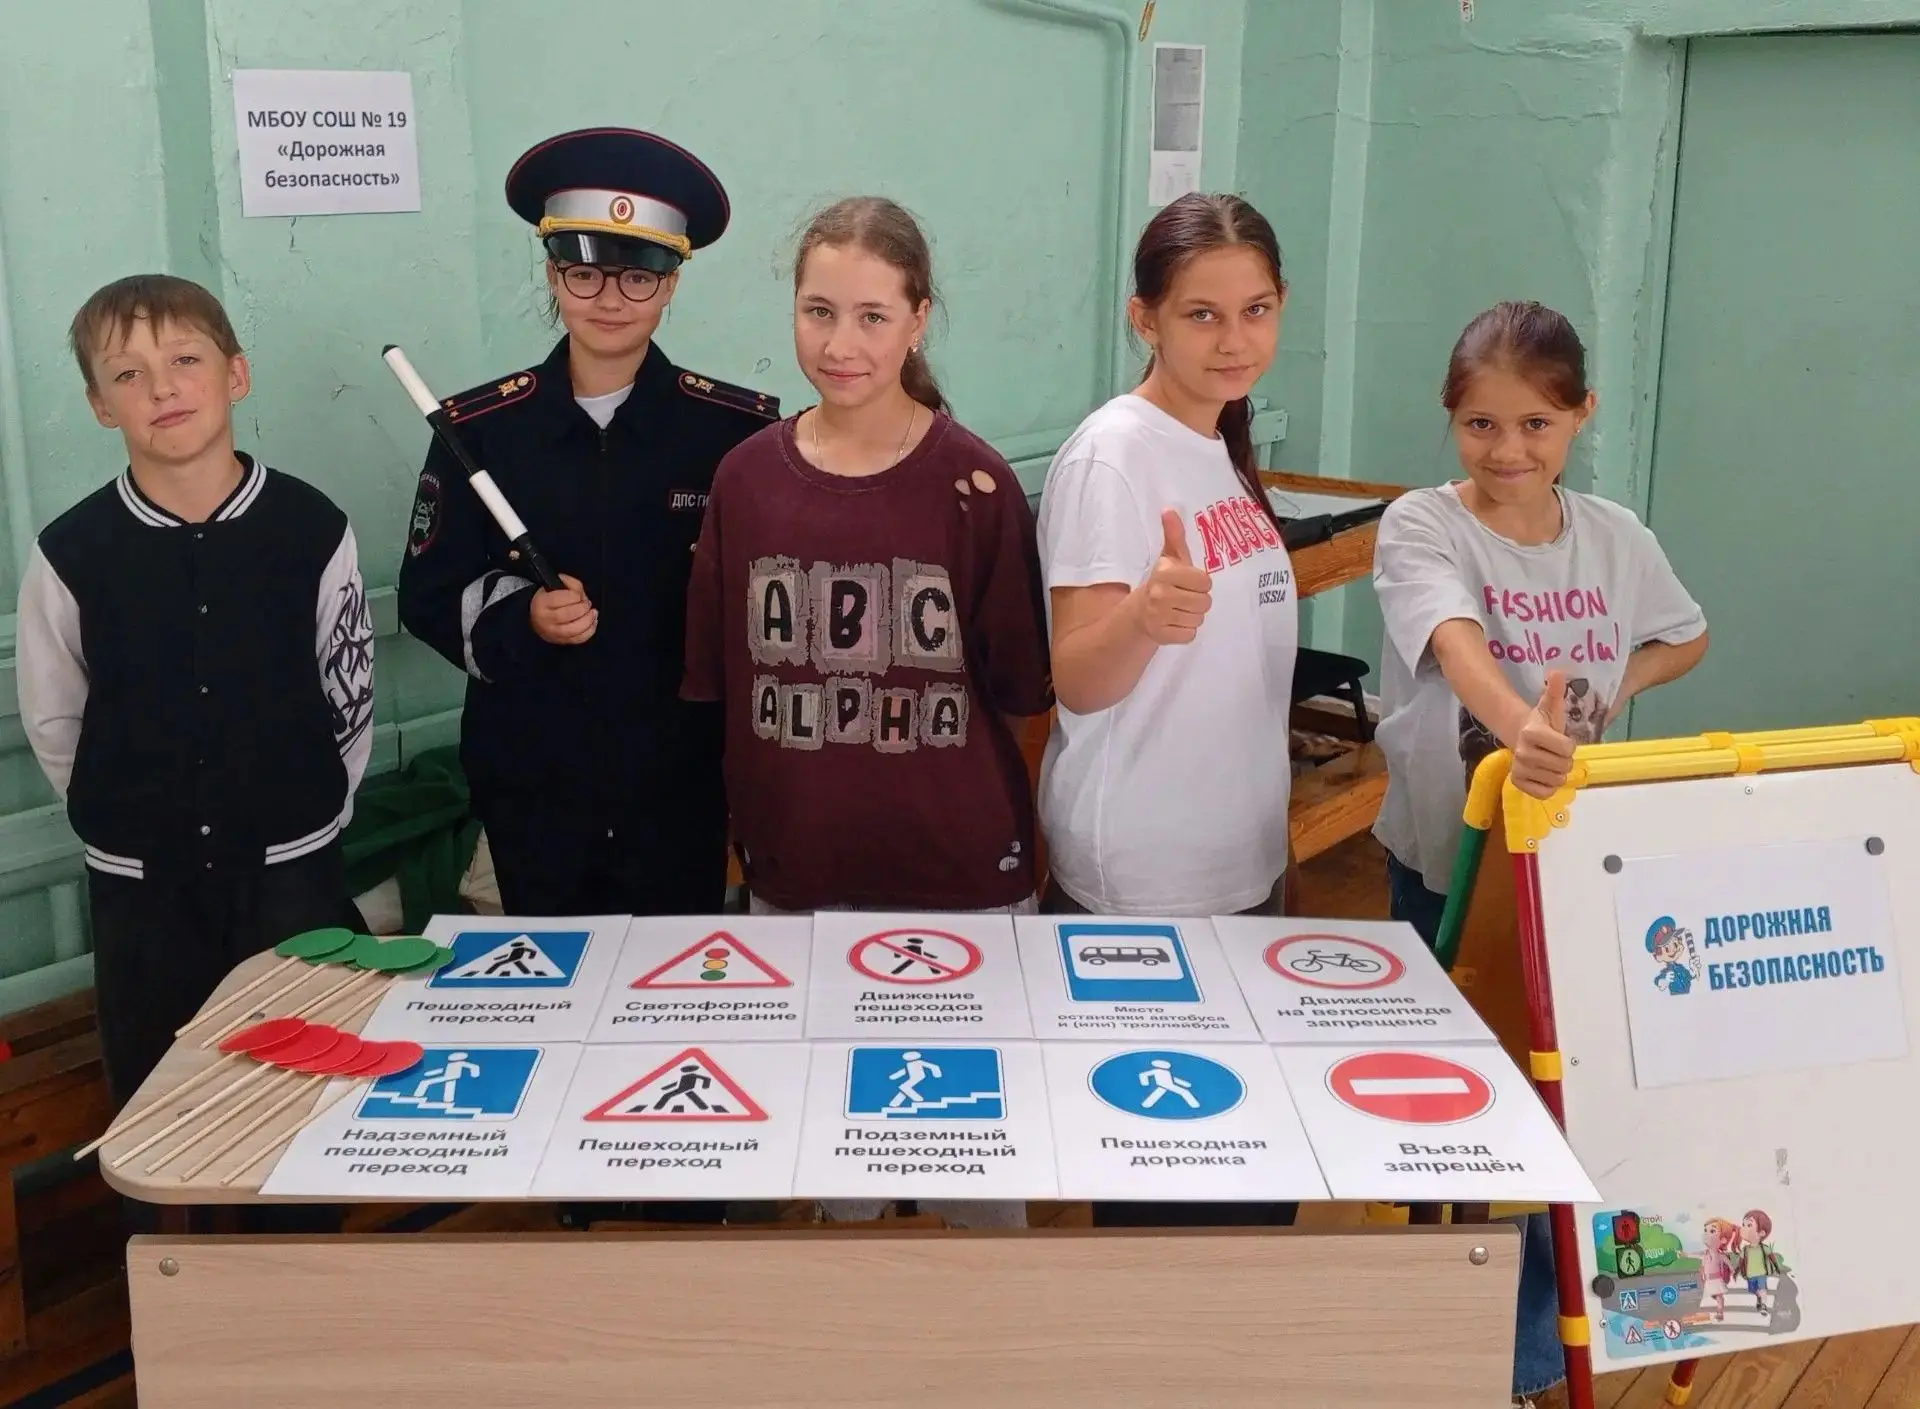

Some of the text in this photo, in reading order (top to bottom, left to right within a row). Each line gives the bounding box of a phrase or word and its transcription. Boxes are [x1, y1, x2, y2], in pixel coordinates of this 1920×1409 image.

[247, 110, 407, 128] МБОУ СОШ № 19
[277, 141, 385, 161] «Дорожная
[265, 170, 400, 188] безопасность»
[672, 493, 697, 509] ДПС
[1194, 495, 1280, 575] MOSC
[759, 686, 960, 742] ALPHA
[1704, 905, 1832, 949] ДОРОЖНАЯ
[1707, 946, 1885, 991] БЕЗОПАСНОСТЬ
[859, 991, 975, 1002] Движение
[1299, 996, 1416, 1007] Движение
[405, 1000, 573, 1012] Пешеходный
[624, 1000, 790, 1012] Светофорное
[853, 1003, 983, 1012] пешеходов
[1114, 1005, 1165, 1013] Место
[1277, 1006, 1453, 1017] на велосипеде
[429, 1014, 536, 1025] переход
[611, 1012, 798, 1025] регулирование
[853, 1015, 984, 1024] запрещено
[1073, 1020, 1117, 1030] (или)
[1121, 1021, 1231, 1030] троллейбуса
[1149, 1013, 1226, 1023] автобуса
[1305, 1017, 1438, 1029] запрещено
[341, 1128, 508, 1142] Надземный
[843, 1127, 1007, 1142] Подземный
[323, 1144, 509, 1158] пешеходный
[578, 1137, 760, 1153] Пешеходный
[834, 1144, 1017, 1158] пешеходный
[1099, 1137, 1268, 1151] Пешеходная
[1398, 1142, 1493, 1156] Въезд
[606, 1157, 723, 1170] переход
[1129, 1155, 1247, 1168] дорожка
[1383, 1159, 1526, 1175] запрещён
[347, 1163, 469, 1176] переход
[866, 1162, 986, 1176] переход
